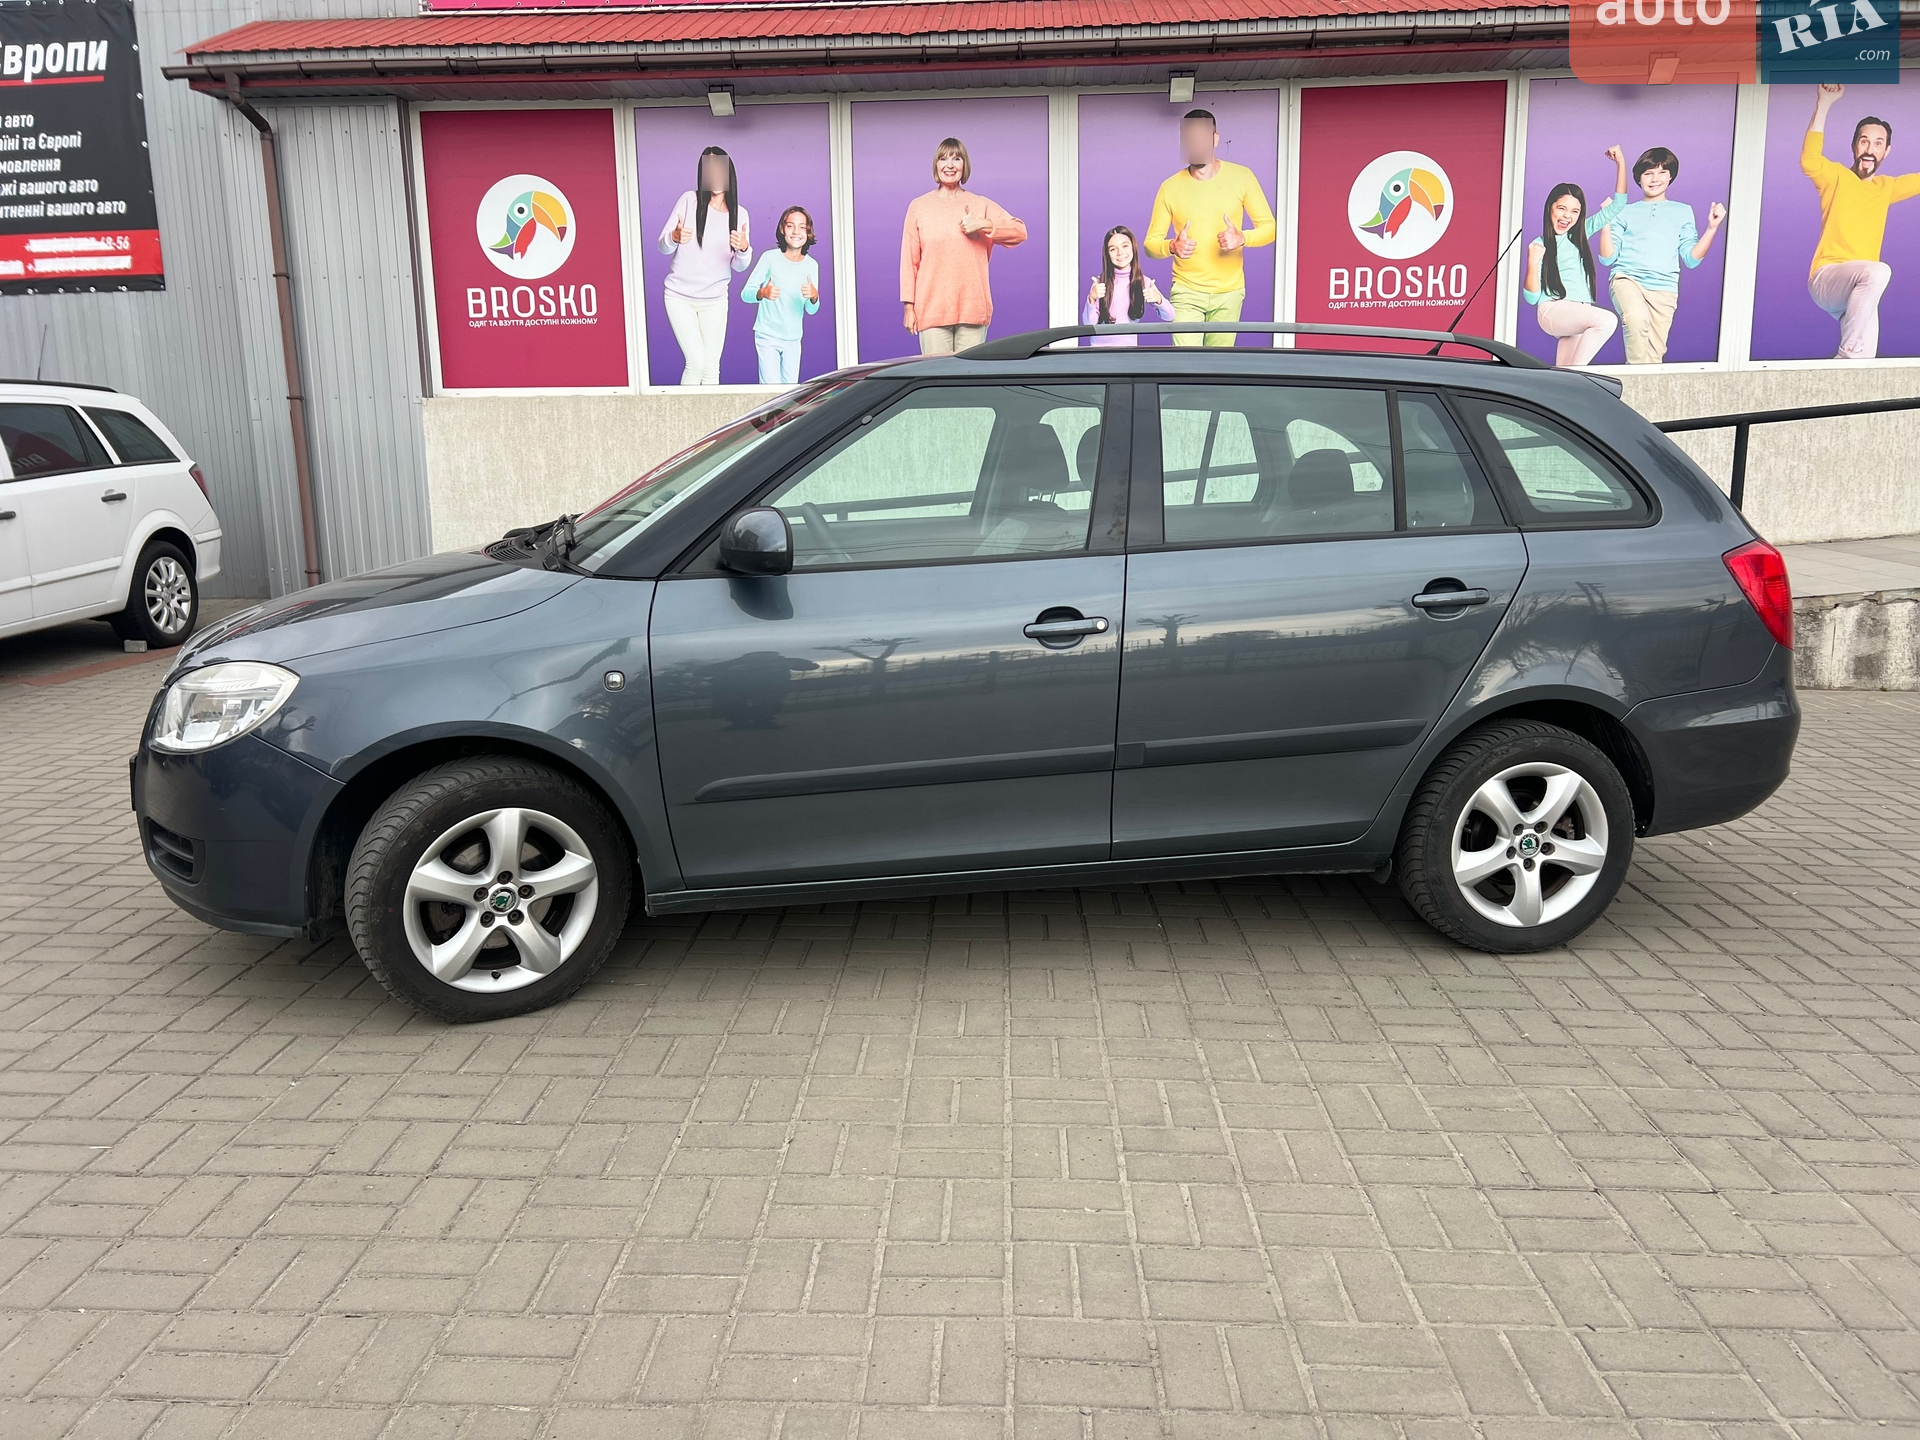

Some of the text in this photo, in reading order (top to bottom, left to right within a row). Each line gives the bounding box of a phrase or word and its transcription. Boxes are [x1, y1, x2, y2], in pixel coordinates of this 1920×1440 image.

[0, 40, 108, 84] вропи
[4, 114, 34, 128] авто
[22, 136, 36, 150] та
[38, 130, 82, 152] Європі
[19, 181, 67, 195] вашого
[68, 178, 99, 193] авто
[46, 202, 95, 217] вашого
[96, 200, 127, 215] авто
[1328, 263, 1468, 300] BROSKO
[466, 283, 598, 319] BROSKO
[1328, 301, 1348, 310] ОДЯГ
[1387, 299, 1425, 309] ДОСТУПНІ
[1426, 299, 1466, 307] КОЖНОМУ
[468, 317, 598, 328] ОДЯГ ТА ВЗУТТЯ ДОСТУПНІ КОЖНОМУ
